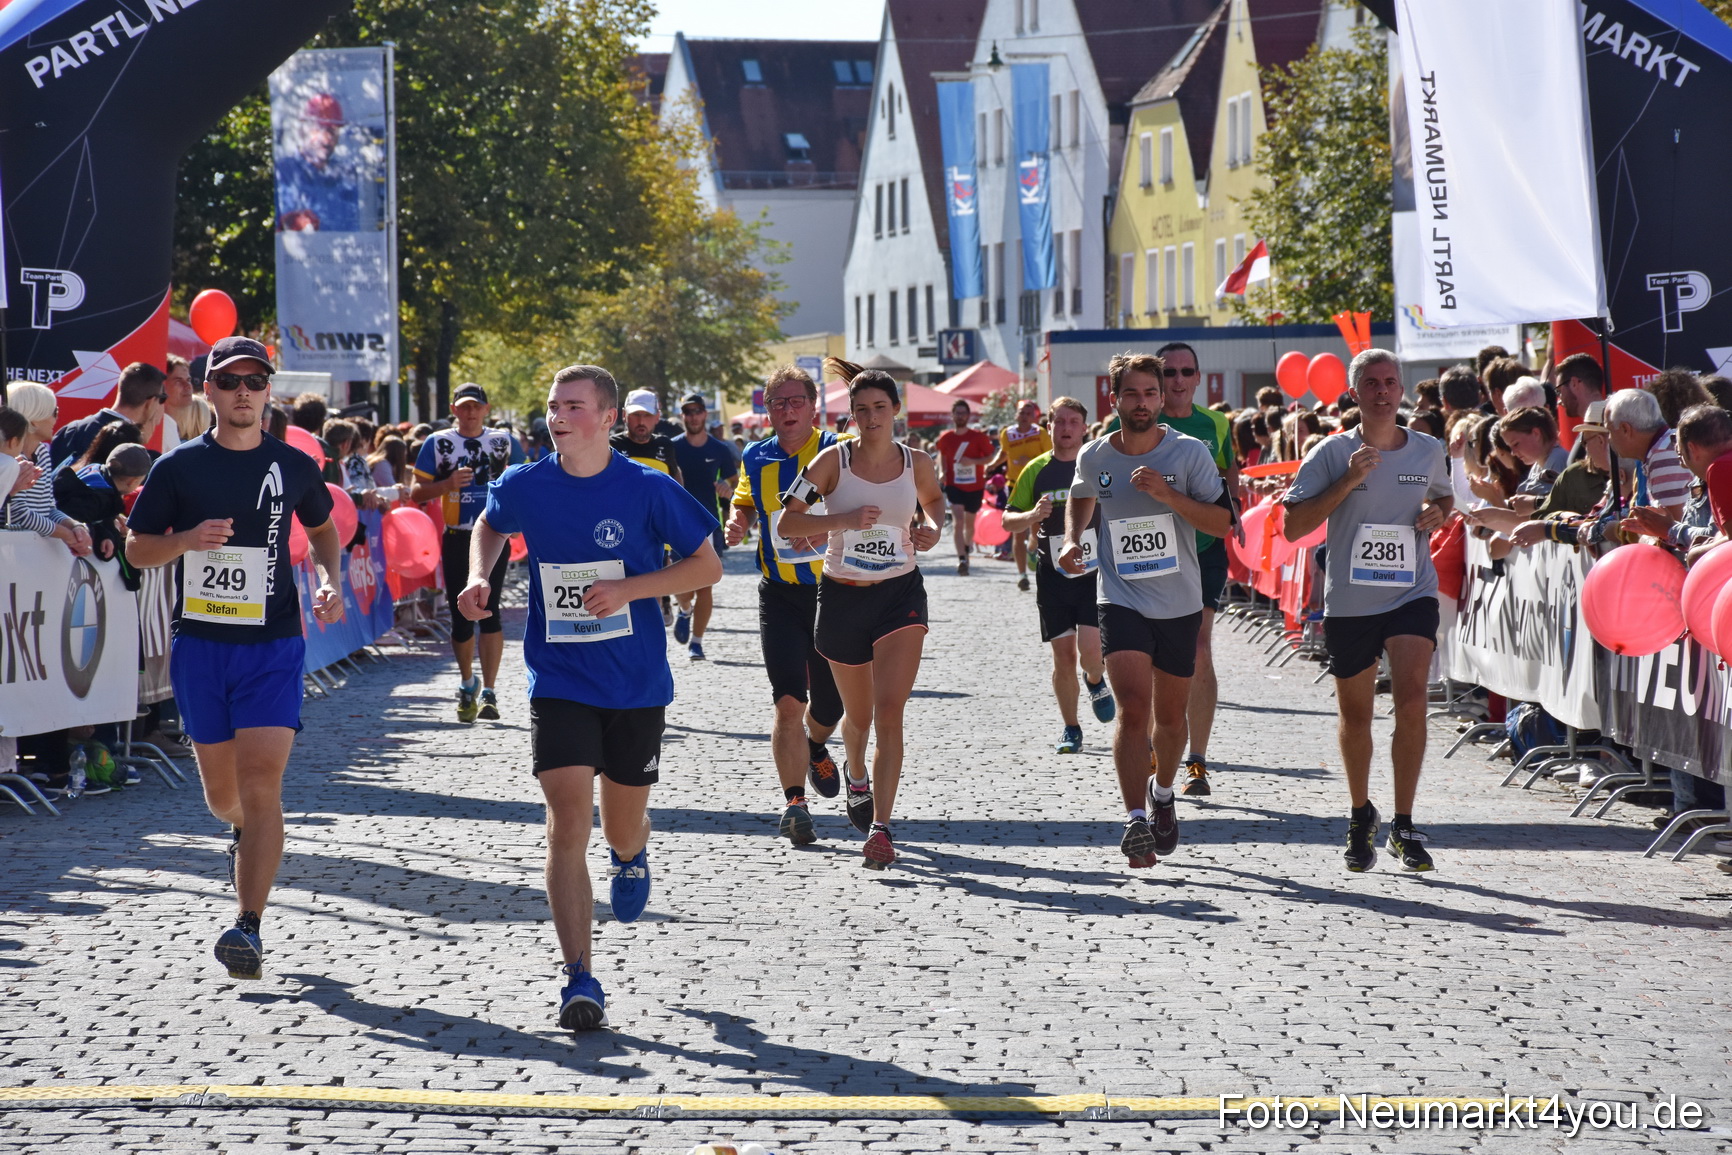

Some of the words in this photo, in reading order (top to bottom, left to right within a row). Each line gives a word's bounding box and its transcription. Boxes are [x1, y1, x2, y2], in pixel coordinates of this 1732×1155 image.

[24, 10, 149, 89] PARTL
[1580, 2, 1701, 88] MARKT
[953, 165, 975, 217] K&L
[25, 272, 44, 280] Team
[45, 273, 62, 281] Partl
[6, 367, 24, 380] HE
[27, 369, 65, 383] NEXT
[1162, 474, 1176, 483] CK
[1398, 474, 1428, 484] BOCK
[1041, 489, 1069, 502] BO
[1126, 521, 1156, 531] BOCK
[862, 530, 889, 539] BOCK
[1371, 529, 1399, 538] BOCK
[854, 540, 896, 557] 2254
[1120, 531, 1167, 554] 2630
[207, 551, 243, 562] BOCK
[1361, 541, 1405, 562] 2381
[1134, 562, 1159, 572] Stefan
[202, 565, 246, 592] 249
[562, 569, 598, 580] BOCK
[1373, 571, 1395, 580] David
[554, 584, 593, 609] 25
[206, 603, 238, 615] Stefan
[0, 582, 48, 685] rkt
[573, 622, 601, 634] Kevin
